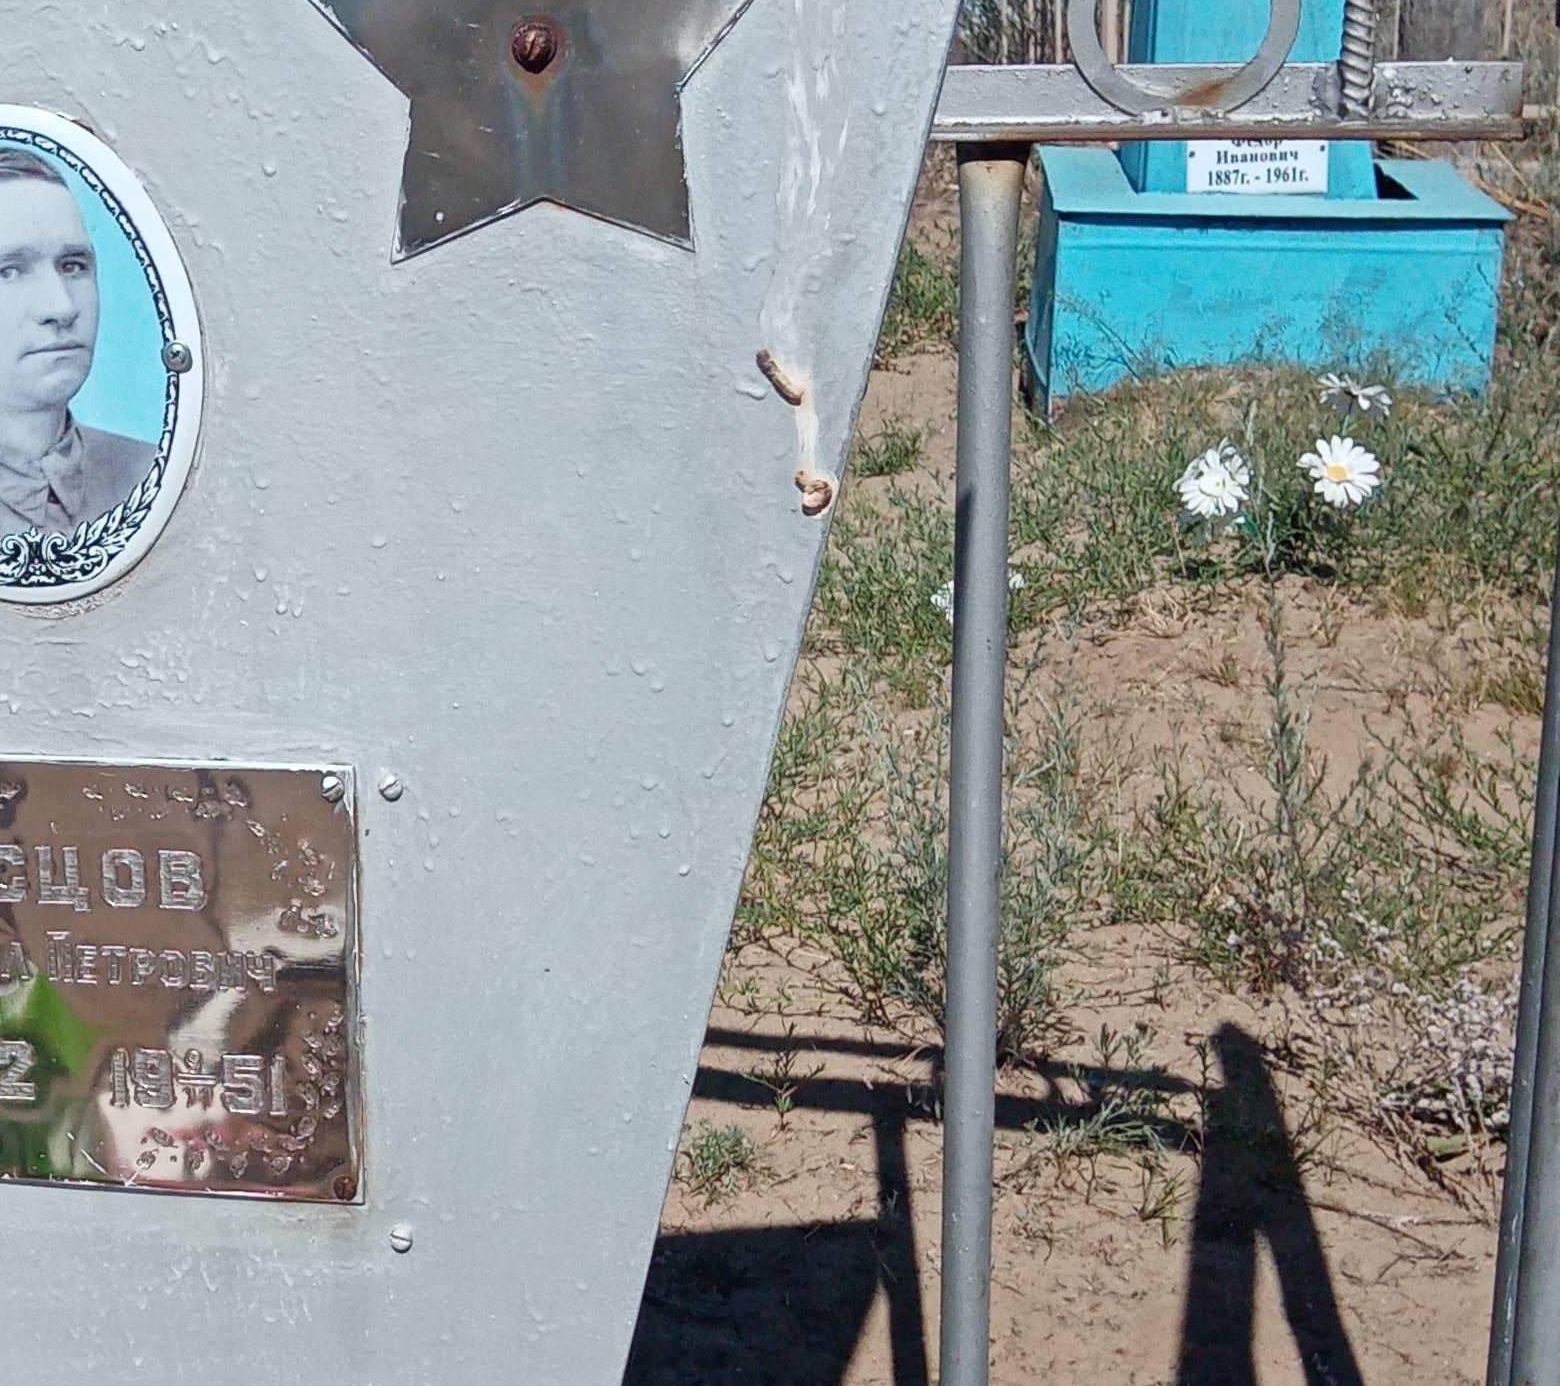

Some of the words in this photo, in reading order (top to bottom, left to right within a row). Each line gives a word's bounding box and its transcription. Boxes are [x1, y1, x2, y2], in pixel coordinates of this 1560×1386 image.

[1216, 150, 1299, 164] Иванович
[1207, 170, 1250, 187] 1887г.
[1265, 166, 1309, 184] 1961г.
